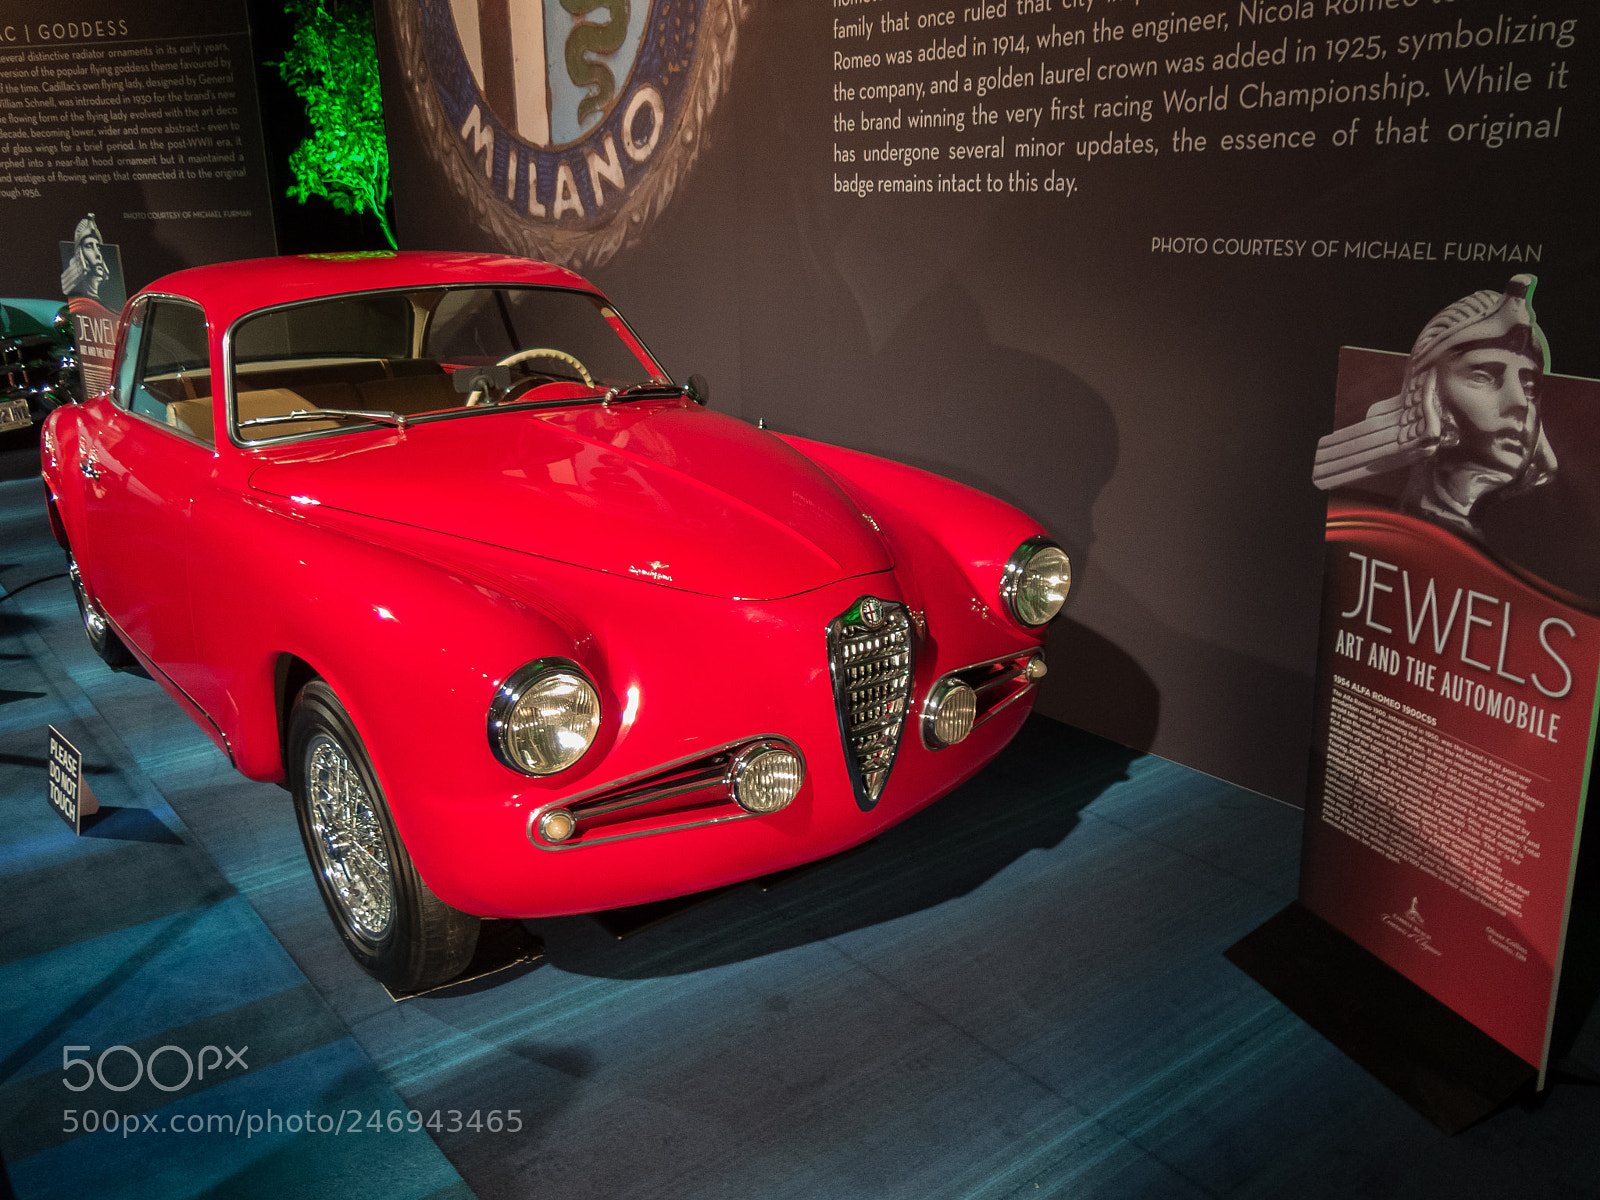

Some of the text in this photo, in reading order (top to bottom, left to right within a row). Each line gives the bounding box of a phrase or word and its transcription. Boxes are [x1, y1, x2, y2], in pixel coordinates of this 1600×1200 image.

[38, 20, 128, 41] GODDESS
[834, 0, 1052, 40] family that once ruled that
[834, 0, 1314, 70] Romeo was added in 1914, when the engineer, Nicola
[834, 14, 1578, 103] the company, and a golden laurel crown was added in 1925, symbolizing
[834, 61, 1569, 133] the brand winning the very first racing World Championship. While it
[461, 85, 664, 220] MILANO
[834, 106, 1563, 167] has undergone several minor updates, the essence of that original
[834, 169, 1078, 198] badge remains intact to this day.
[1151, 237, 1543, 263] PHOTO COURTESY OF MICHAEL FURMAN
[76, 314, 120, 346] JEWEL
[1341, 551, 1576, 698] JEWELS
[1332, 674, 1350, 688] 1954
[1350, 682, 1371, 697] ALFA
[1371, 691, 1401, 710] ROMEO
[1335, 629, 1561, 744] ART AND THE AUTOMOBILE
[50, 738, 78, 778] PLEASE
[50, 760, 77, 800] DO NOT
[49, 780, 76, 822] TOUCH
